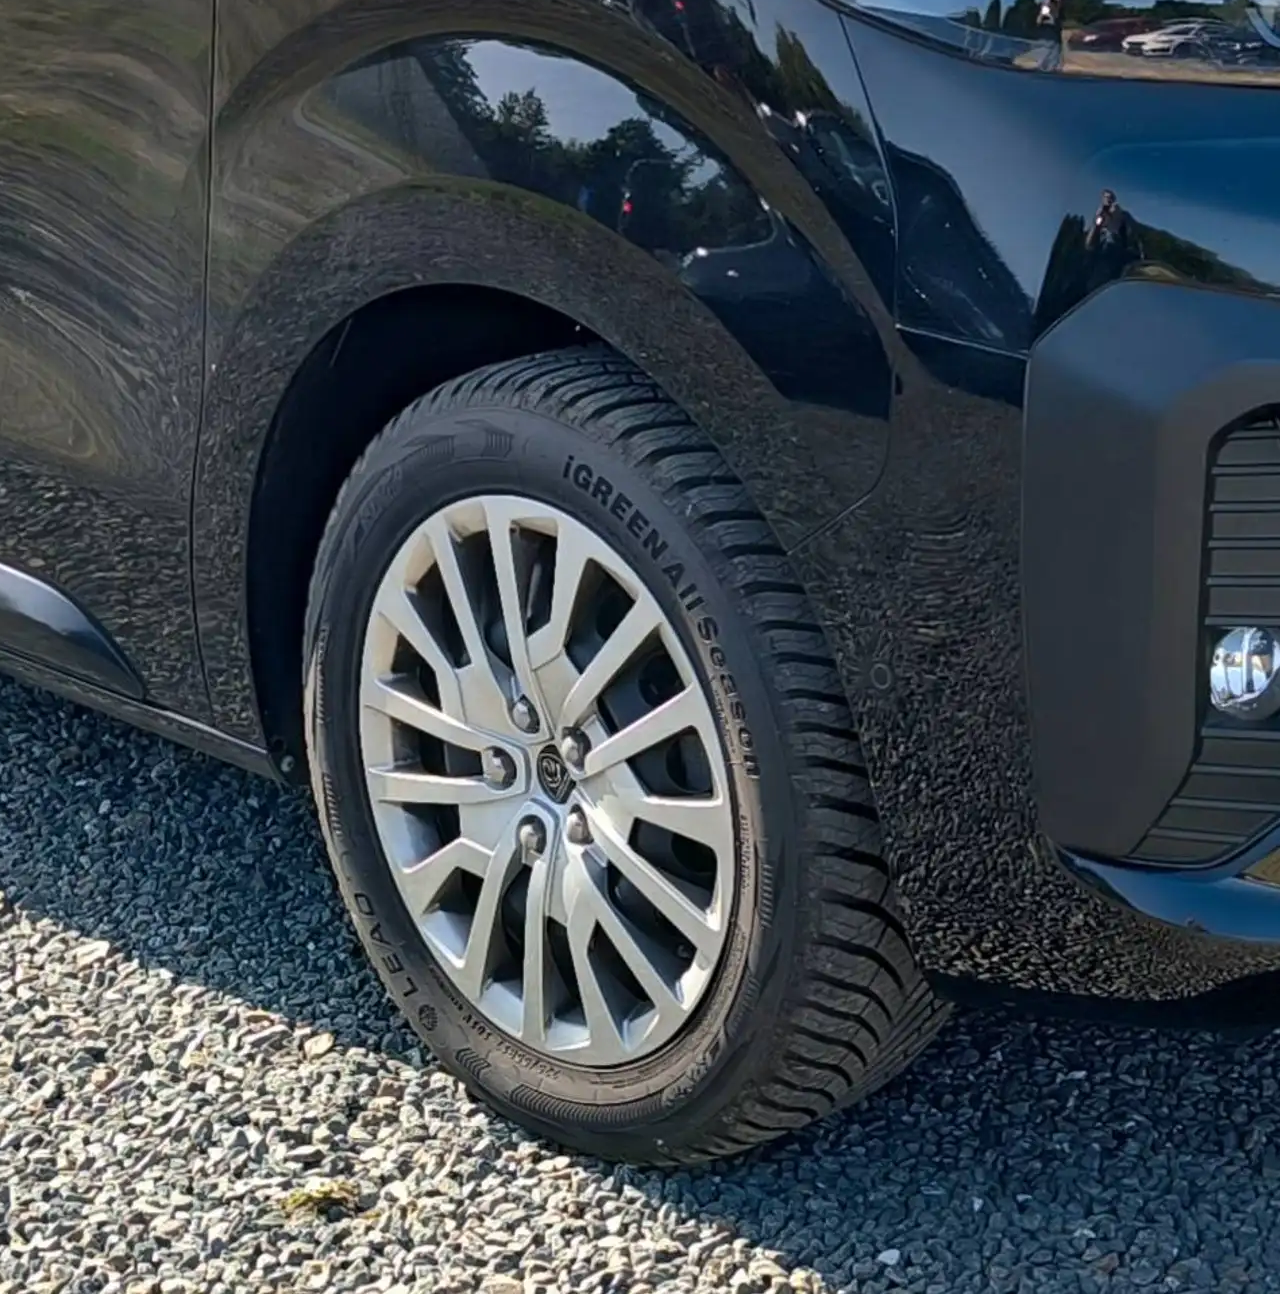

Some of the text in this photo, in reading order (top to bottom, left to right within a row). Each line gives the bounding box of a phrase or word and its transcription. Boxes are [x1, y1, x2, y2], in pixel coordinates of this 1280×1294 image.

[562, 454, 669, 561] iGREEN
[662, 562, 705, 611] All
[696, 616, 761, 779] Season
[354, 892, 419, 998] LEAO
